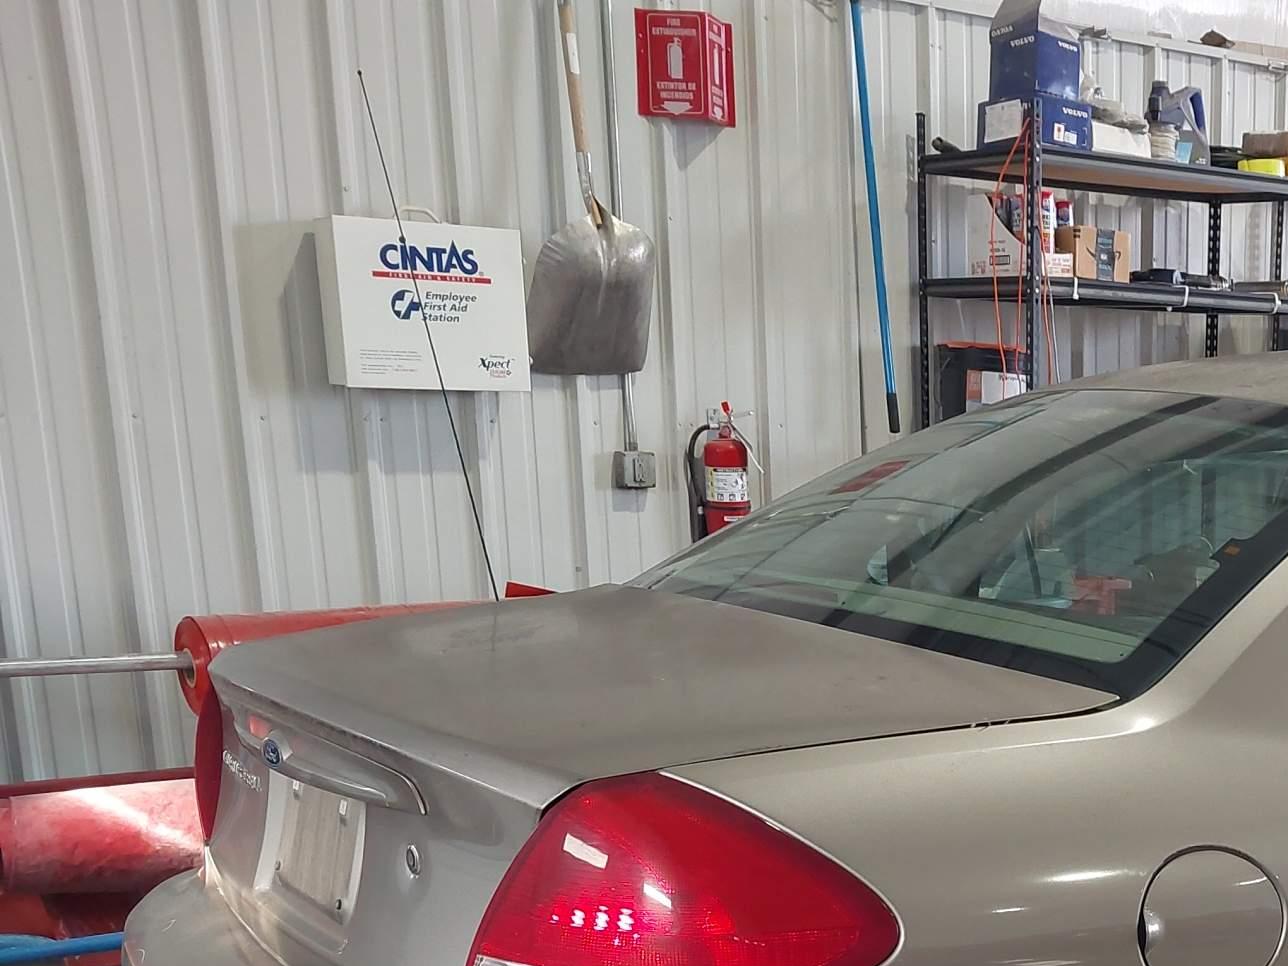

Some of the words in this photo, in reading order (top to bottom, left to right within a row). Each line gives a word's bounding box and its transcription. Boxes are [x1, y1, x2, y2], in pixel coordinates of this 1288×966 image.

[1009, 35, 1035, 47] VOLVO
[1058, 40, 1078, 52] VOLVO
[1062, 106, 1088, 118] VOLVO
[380, 240, 479, 275] CINTAS
[425, 291, 478, 305] Employee
[424, 302, 446, 312] First
[450, 304, 468, 313] Aid
[421, 313, 460, 323] Station
[478, 357, 511, 371] Xpect
